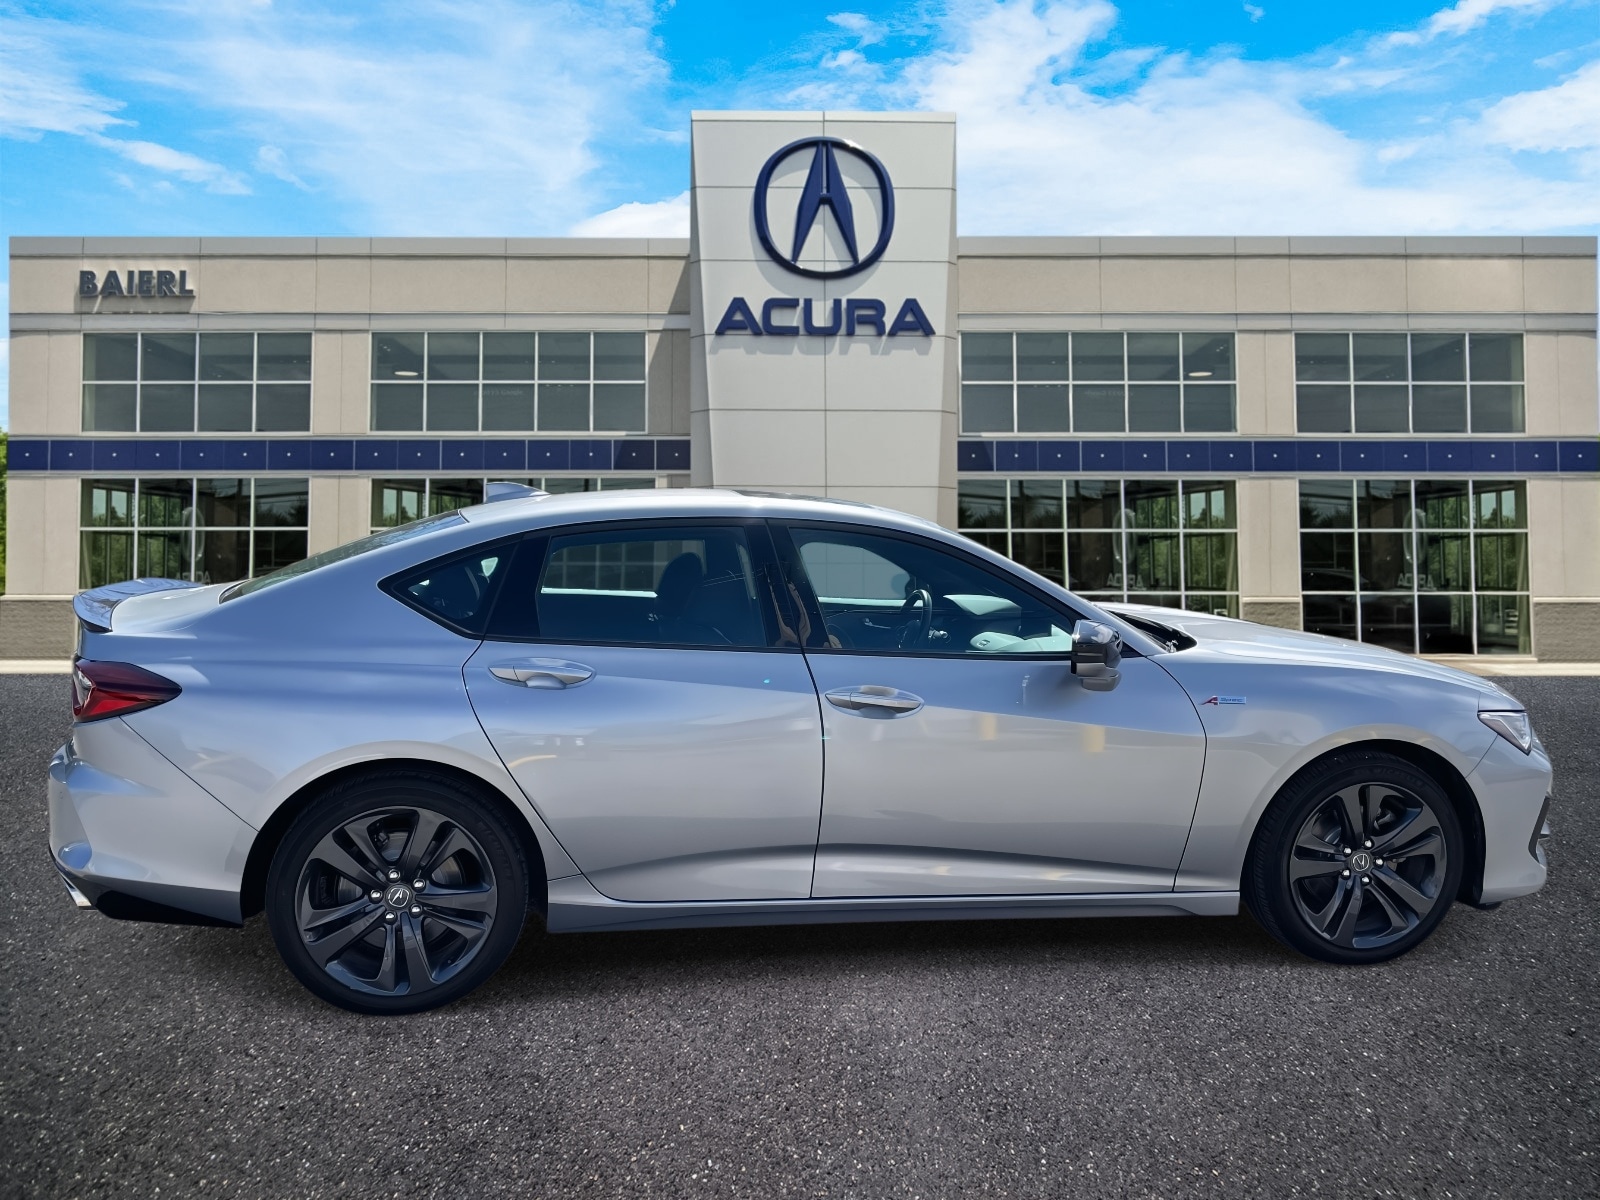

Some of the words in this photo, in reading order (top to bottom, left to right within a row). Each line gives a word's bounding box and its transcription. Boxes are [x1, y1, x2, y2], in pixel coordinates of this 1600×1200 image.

[79, 270, 194, 297] BAIERL
[715, 297, 936, 336] ACURA
[1106, 573, 1144, 587] ACRA
[1396, 573, 1434, 587] ACRA
